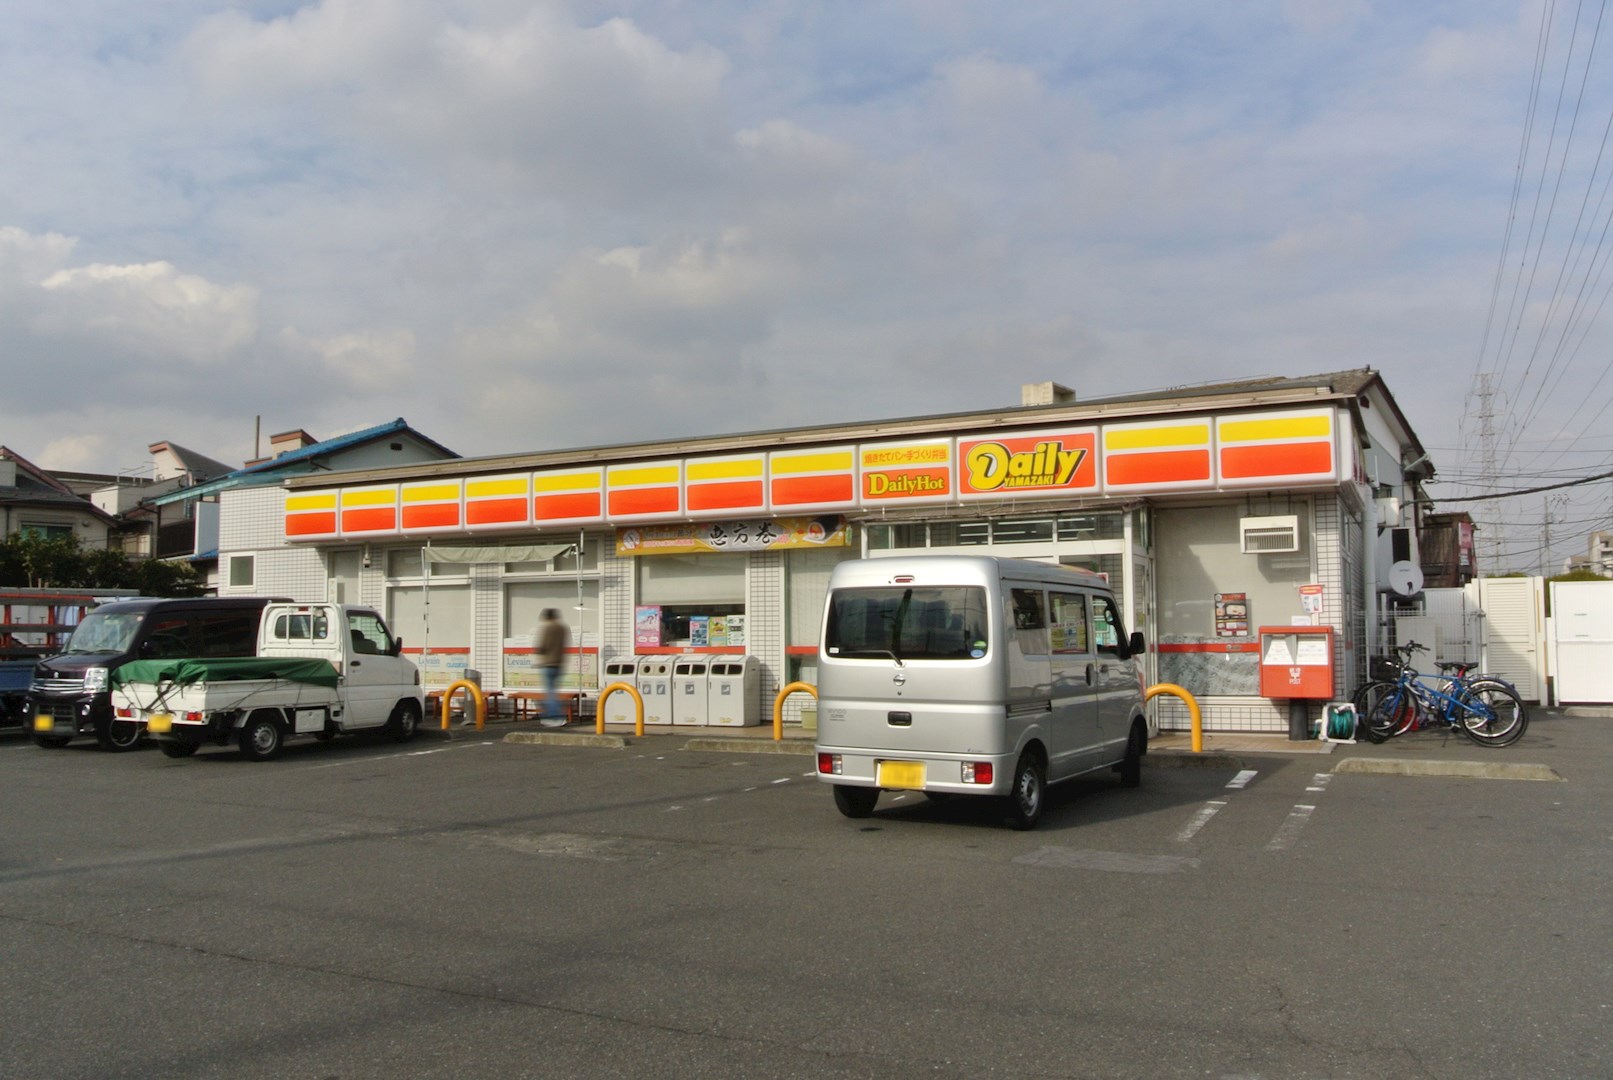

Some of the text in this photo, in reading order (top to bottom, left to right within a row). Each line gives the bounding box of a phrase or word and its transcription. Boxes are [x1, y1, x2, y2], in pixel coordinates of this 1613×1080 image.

[967, 442, 1086, 490] Daily
[1005, 475, 1054, 488] YAMAZAKI
[710, 521, 777, 546] 恵方巻
[507, 657, 531, 666] Levain
